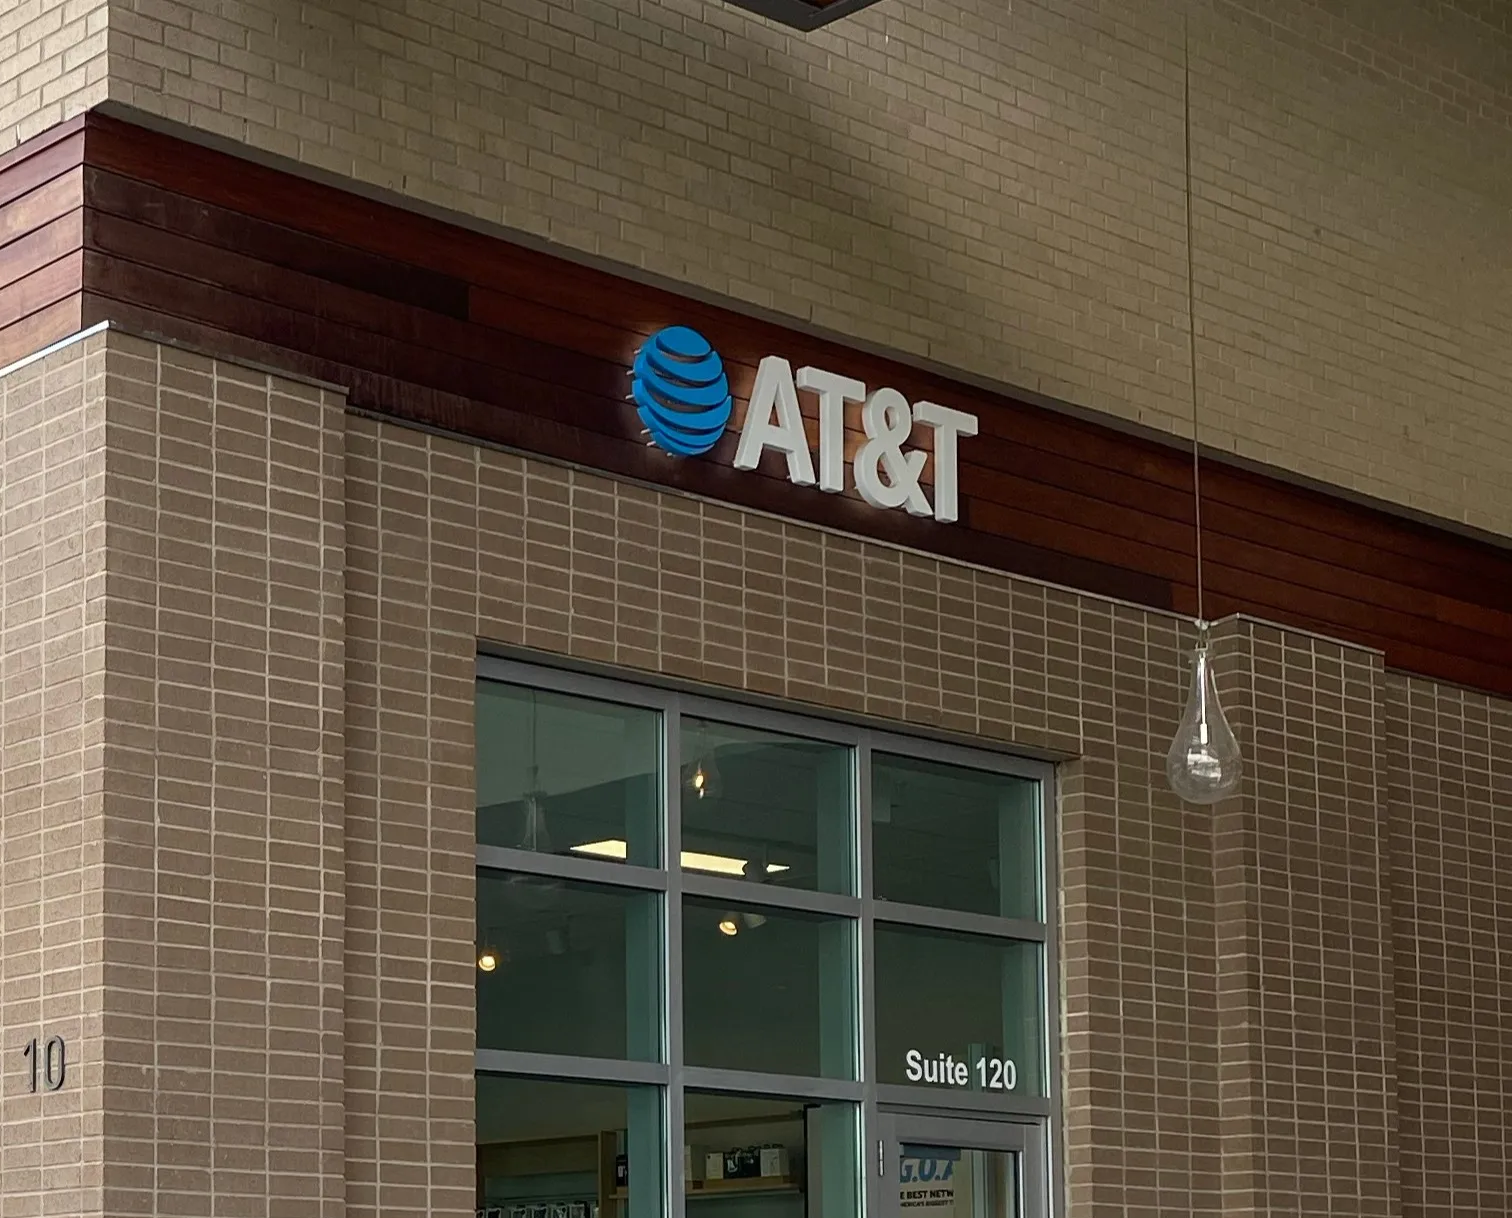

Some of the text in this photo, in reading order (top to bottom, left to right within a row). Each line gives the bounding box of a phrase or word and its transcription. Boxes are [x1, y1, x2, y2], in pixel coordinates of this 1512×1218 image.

[733, 355, 979, 524] AT&T
[24, 1034, 65, 1094] 10
[906, 1049, 1017, 1090] Suite 120
[907, 1190, 928, 1199] BEST
[930, 1189, 954, 1198] NETW
